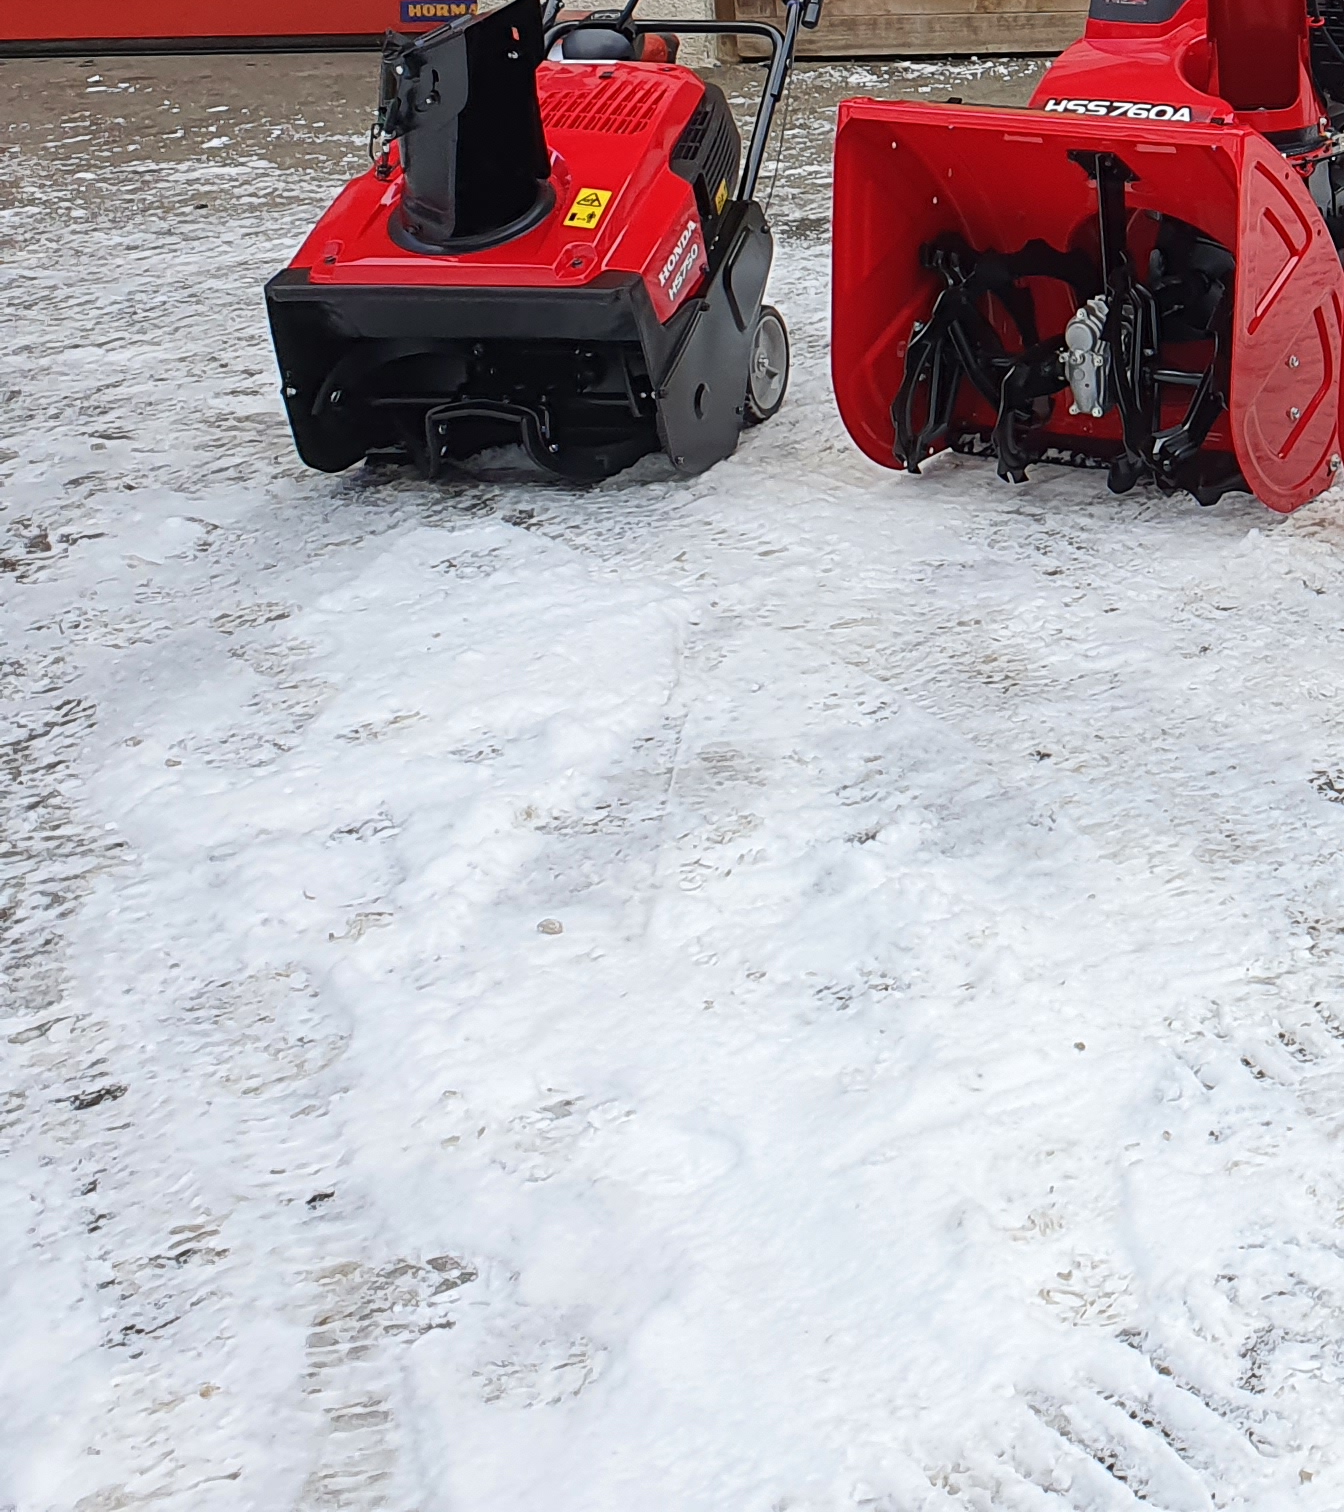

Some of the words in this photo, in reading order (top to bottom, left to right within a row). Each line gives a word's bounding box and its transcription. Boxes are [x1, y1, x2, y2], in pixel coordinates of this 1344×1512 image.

[1045, 99, 1191, 122] HSS760A
[658, 220, 697, 287] HONDA
[668, 243, 698, 301] HS750
